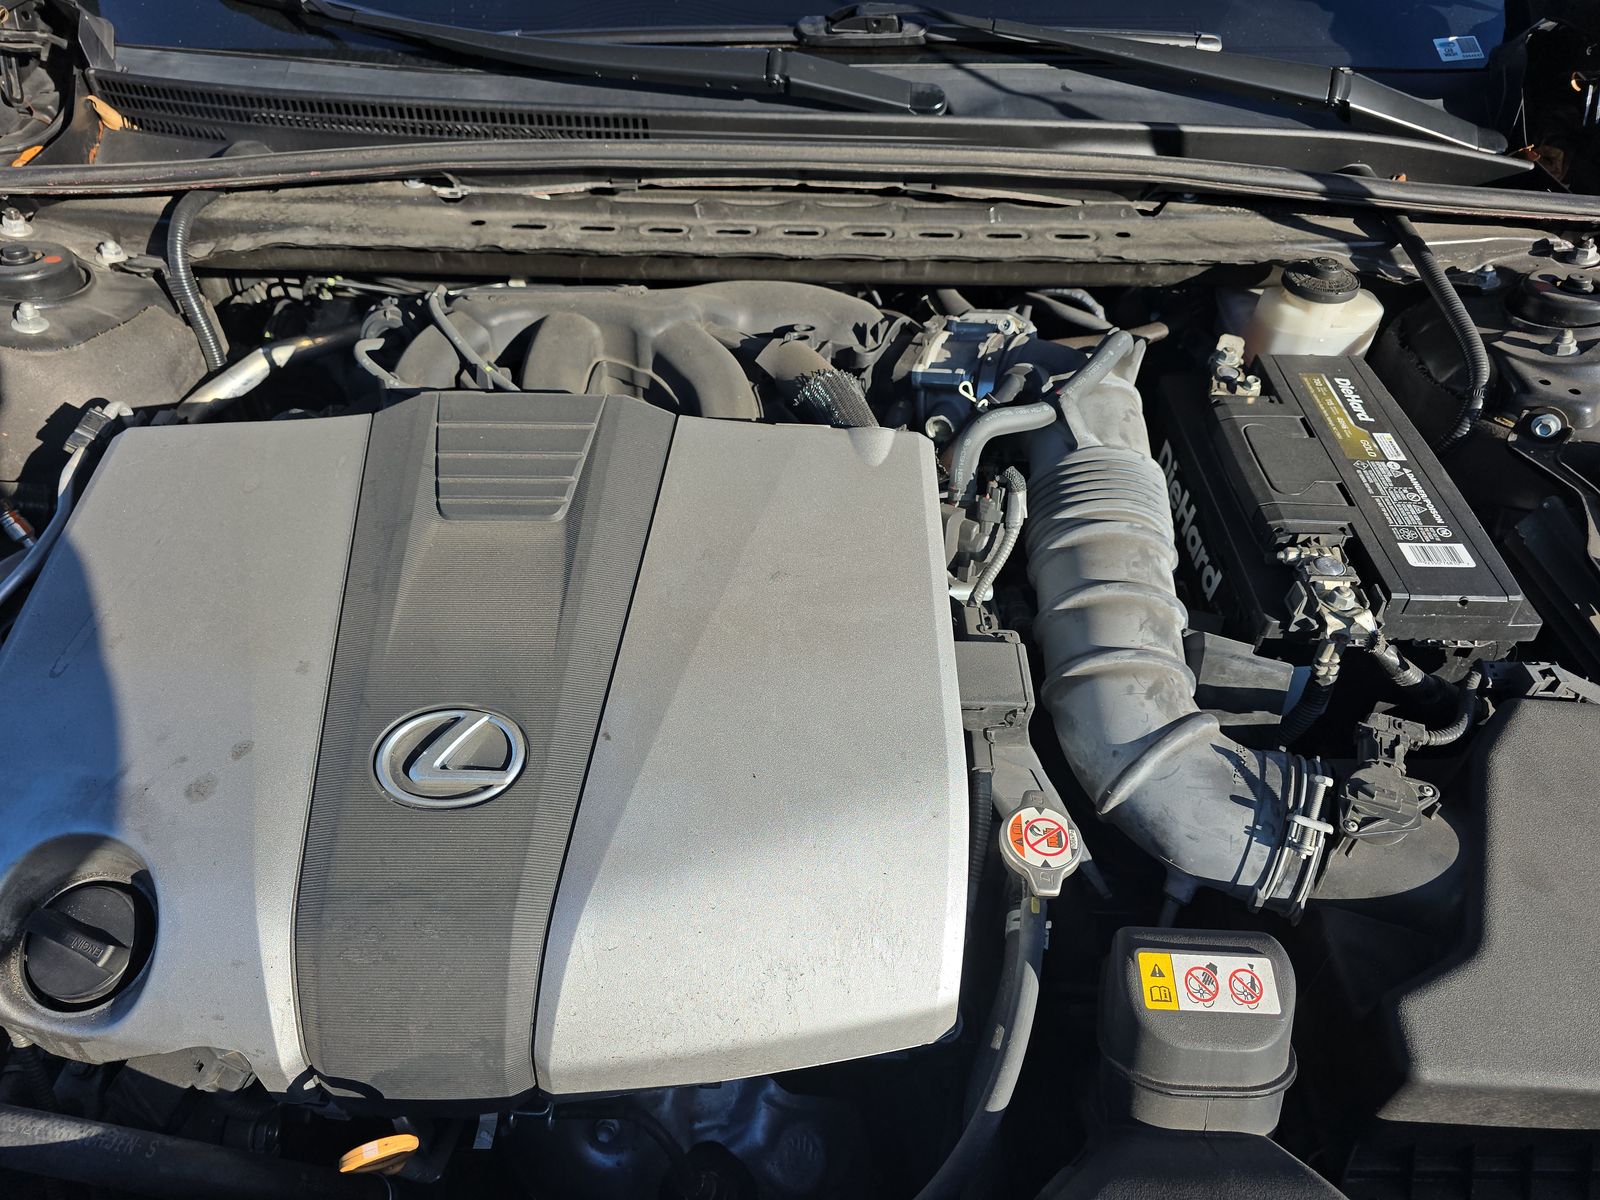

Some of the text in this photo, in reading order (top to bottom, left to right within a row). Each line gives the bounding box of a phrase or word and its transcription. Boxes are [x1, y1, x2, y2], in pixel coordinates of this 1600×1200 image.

[1333, 377, 1376, 423] DieHard
[1360, 439, 1378, 458] GOLD
[1158, 438, 1223, 603] DieHard
[1407, 472, 1446, 525] DANGER/POISON
